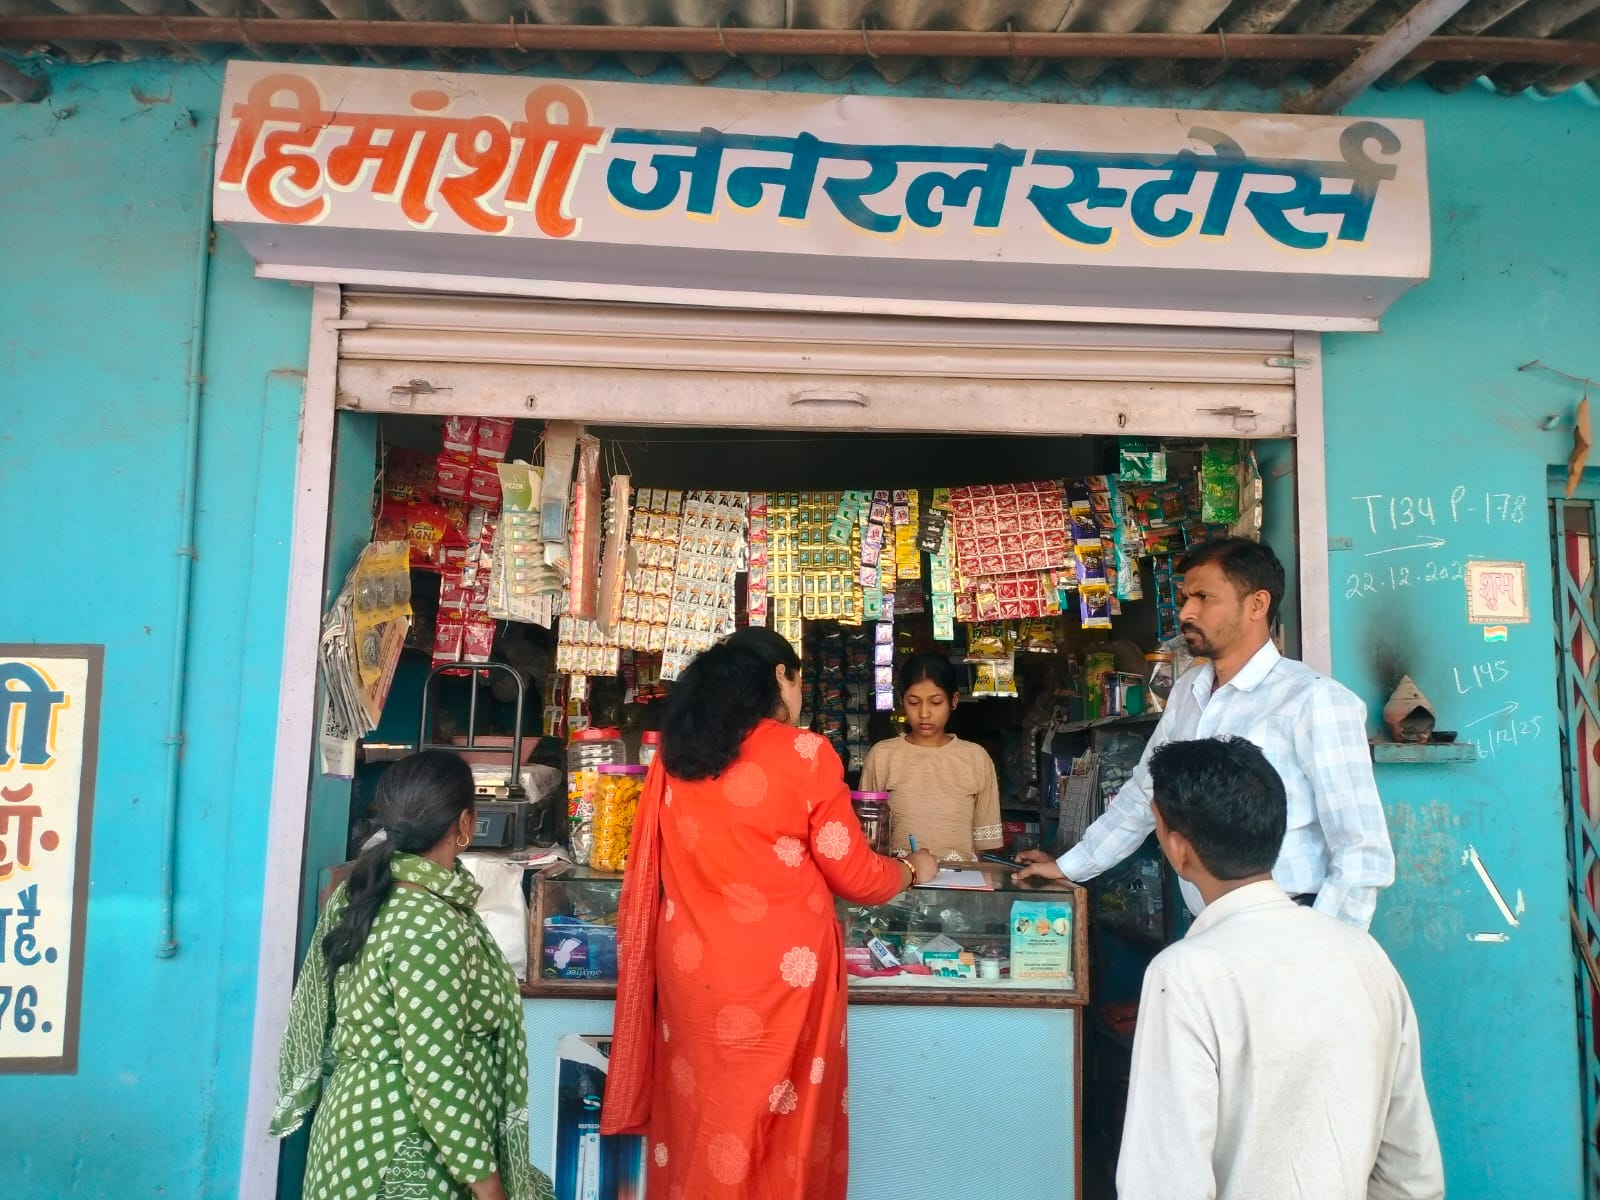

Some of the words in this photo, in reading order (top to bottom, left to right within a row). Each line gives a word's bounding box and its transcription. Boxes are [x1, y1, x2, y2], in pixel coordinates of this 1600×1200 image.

[218, 72, 606, 238] हिमांशी
[605, 126, 1027, 239] जनरल
[1027, 121, 1401, 251] स्टोर्स
[1351, 494, 1436, 534] T134
